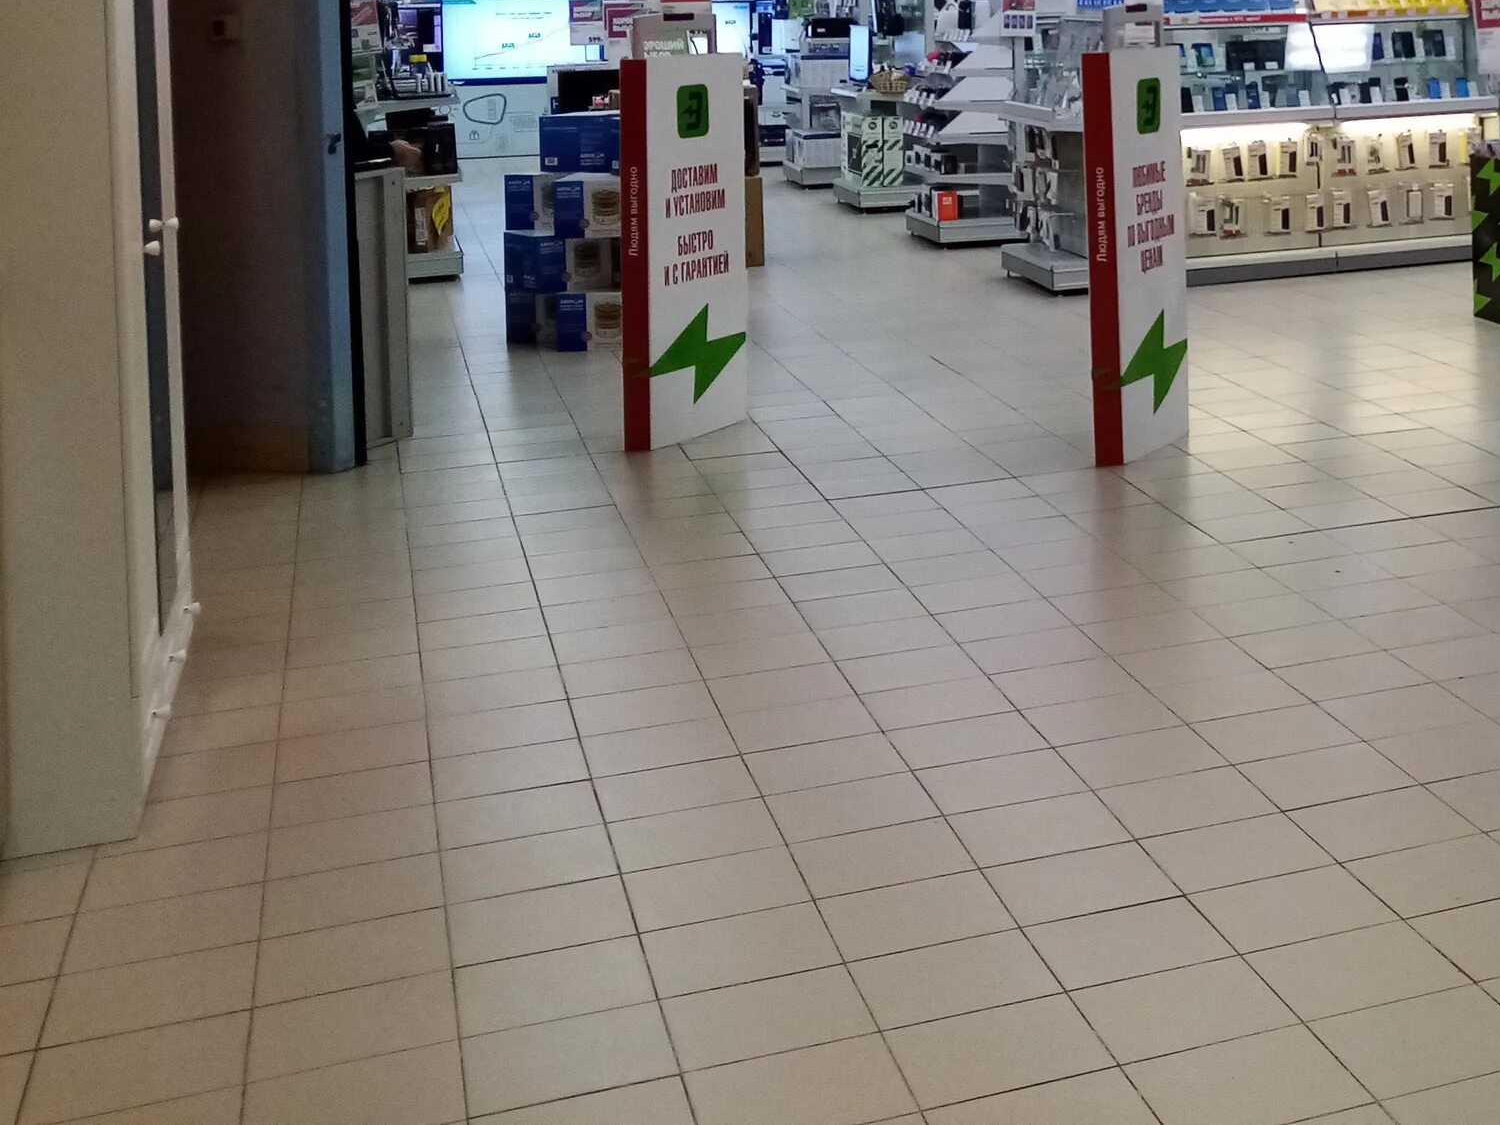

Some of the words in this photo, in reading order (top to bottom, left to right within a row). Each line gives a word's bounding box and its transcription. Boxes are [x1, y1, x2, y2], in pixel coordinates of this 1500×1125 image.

[629, 166, 639, 215] выгодно
[671, 163, 719, 194] ДОСТАВИМ
[1096, 166, 1106, 218] выгодно
[665, 197, 671, 219] И
[673, 188, 726, 217] УСТАНОВИМ
[629, 217, 640, 257] Людям
[677, 229, 714, 257] БЫСТРО
[1097, 220, 1108, 263] Людям
[664, 265, 670, 287] И
[672, 263, 679, 286] С
[681, 250, 730, 283] ГАРАНТИЕЙ
